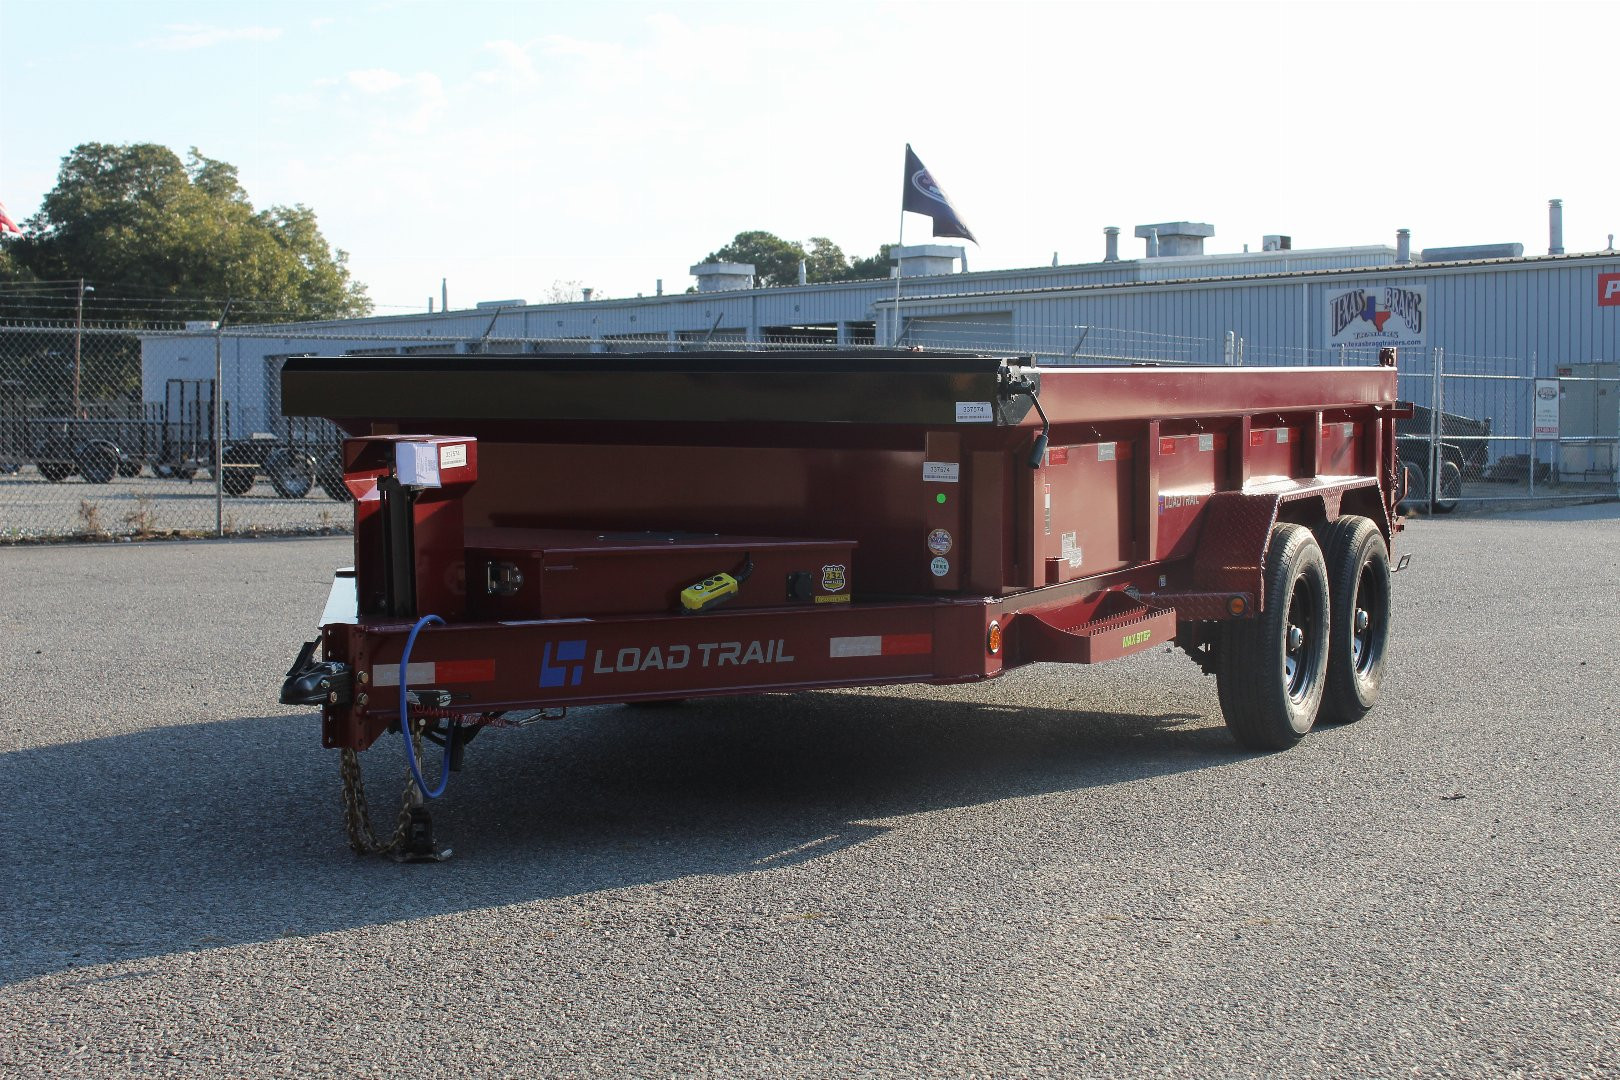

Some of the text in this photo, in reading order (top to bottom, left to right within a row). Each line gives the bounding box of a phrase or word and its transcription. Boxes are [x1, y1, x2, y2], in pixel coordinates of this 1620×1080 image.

[1330, 287, 1422, 337] TEXAS BRAGG
[1122, 629, 1151, 648] MAX STEP
[593, 645, 691, 674] LOAD
[697, 639, 795, 667] TRAIL
